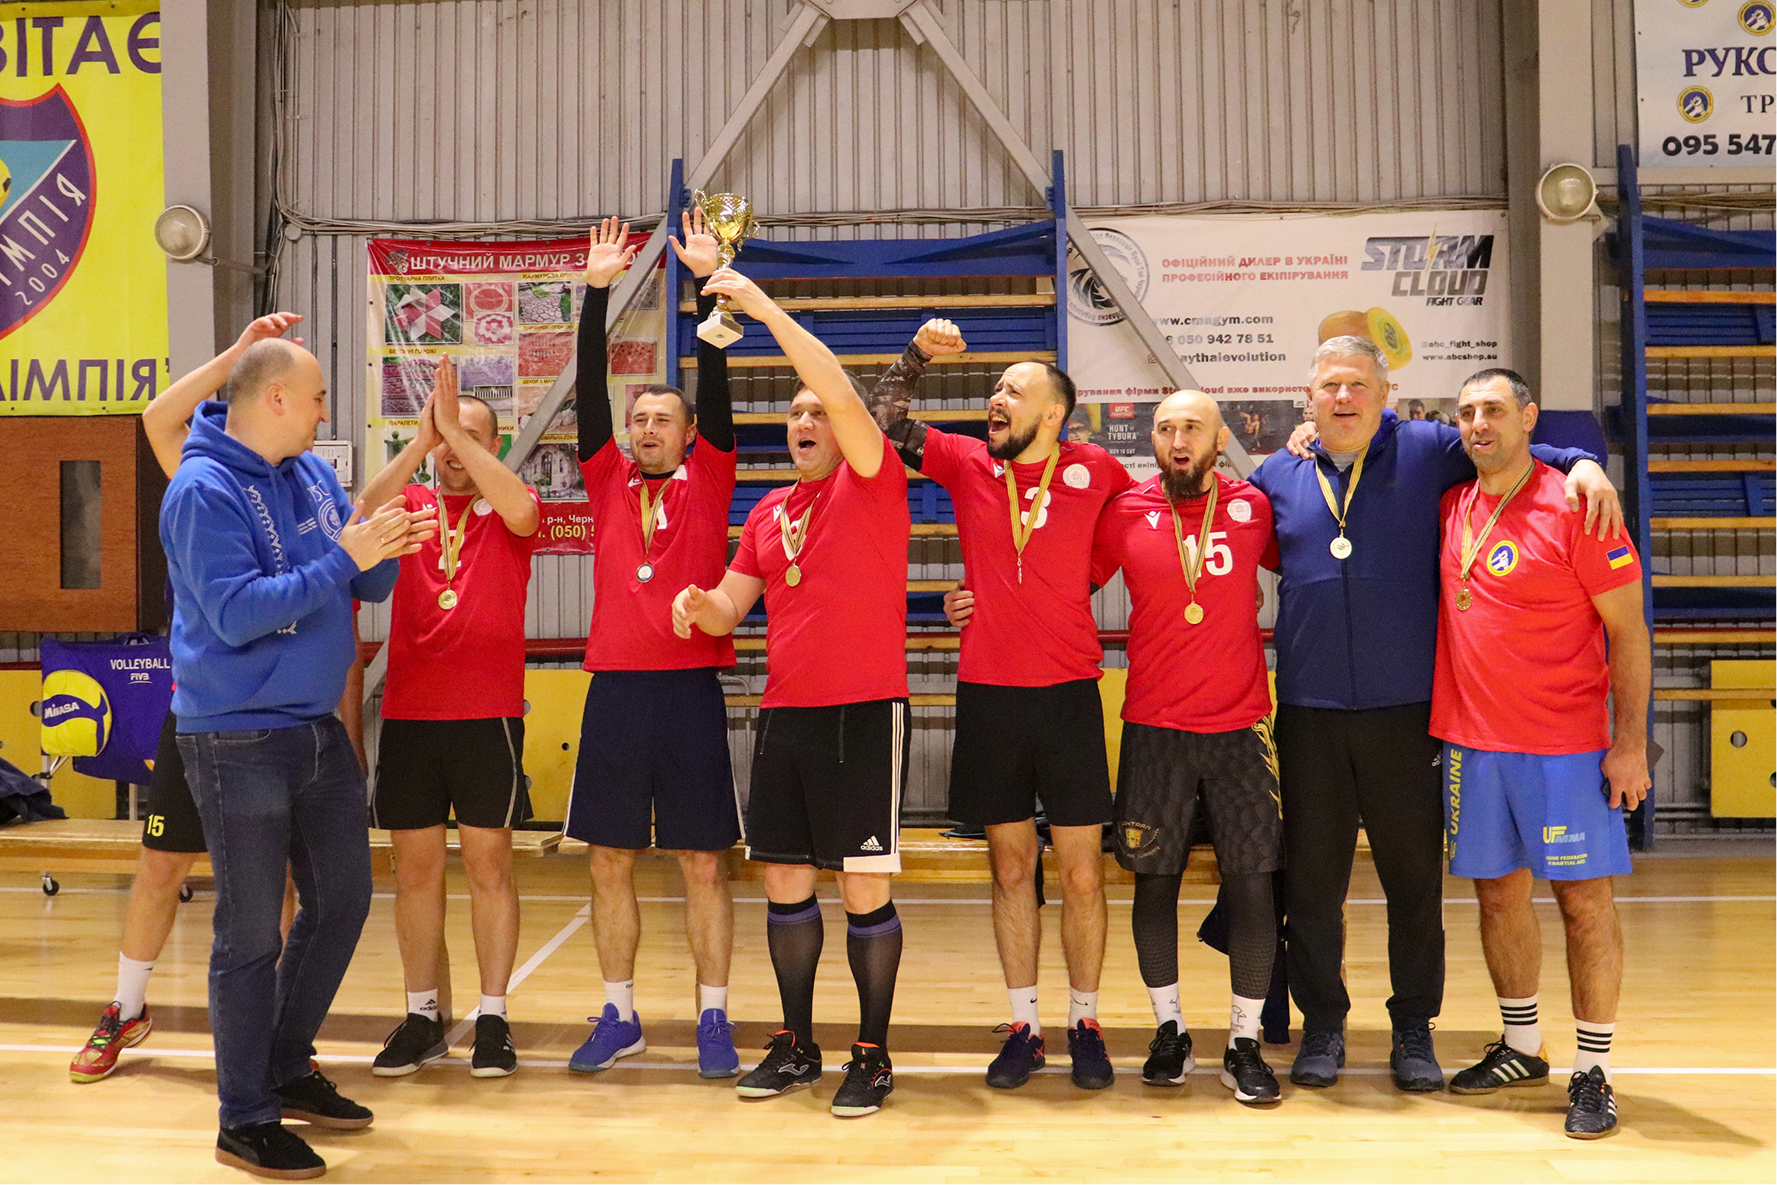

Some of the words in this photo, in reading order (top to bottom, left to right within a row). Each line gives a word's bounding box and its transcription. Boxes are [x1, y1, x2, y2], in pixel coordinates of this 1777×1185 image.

[0, 11, 161, 77] ІТАЄ
[1740, 94, 1777, 114] ТР
[1662, 134, 1719, 156] 095
[1727, 133, 1777, 155] 547
[410, 252, 495, 270] ШТУЧНИЙ
[499, 253, 571, 269] МАРМУР
[1162, 256, 1235, 269] ОФІЦІЙНИЙ
[1239, 256, 1282, 268] ДИЛЕР
[1285, 257, 1294, 266] В
[1297, 254, 1348, 266] УКРАЇНІ
[1361, 235, 1495, 270] STORM
[15, 248, 70, 306] 2004
[1162, 271, 1256, 283] ПРОФЕСІЙНОГО
[1260, 271, 1349, 281] ЕКІПІРУВАННЯ
[1391, 270, 1488, 297] CLOUD
[1426, 297, 1455, 307] FIGHT
[1456, 296, 1484, 306] GEAR
[1178, 335, 1203, 345] 050
[1207, 334, 1232, 345] 942
[1237, 333, 1253, 344] 78
[1257, 333, 1274, 344] 51
[0, 358, 169, 401] ІМПІЯ
[1125, 387, 1159, 397] фірми
[1227, 386, 1250, 394] вже
[1114, 405, 1131, 413] UFC
[1107, 432, 1137, 440] TYBURA
[1108, 424, 1129, 433] HUNT
[1020, 486, 1051, 529] 3
[550, 525, 586, 541] (050)
[1181, 531, 1234, 578] 15
[110, 658, 171, 670] VOLLEYBALL
[130, 672, 150, 681] FIVB
[1449, 748, 1463, 835] UKRAINE
[147, 814, 165, 837] 15
